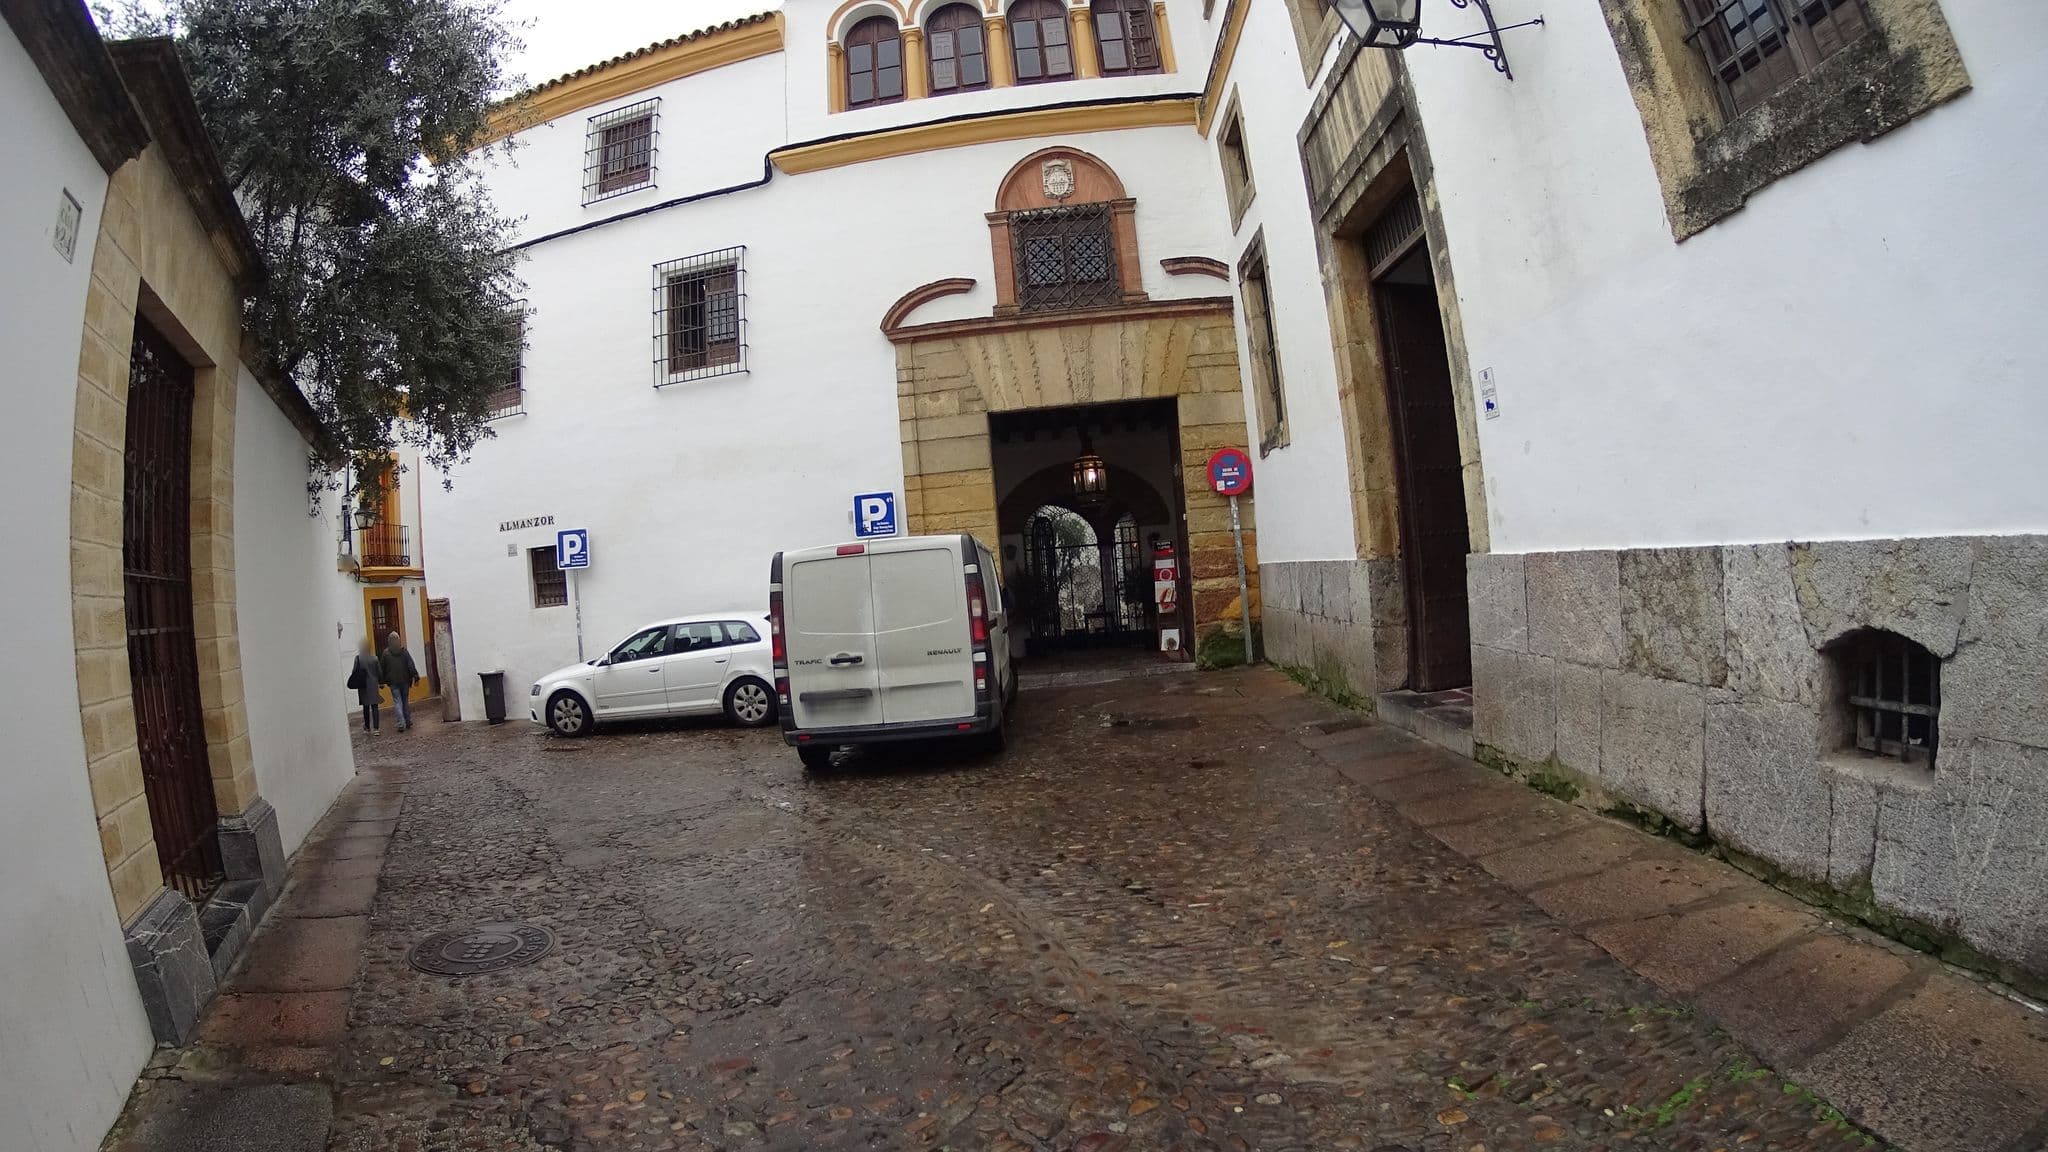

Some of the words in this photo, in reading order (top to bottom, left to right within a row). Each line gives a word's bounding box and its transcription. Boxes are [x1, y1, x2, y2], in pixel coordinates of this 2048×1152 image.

[499, 515, 555, 532] ALMANZOR
[861, 498, 887, 533] P
[563, 533, 582, 565] P
[927, 648, 962, 656] RENAULT
